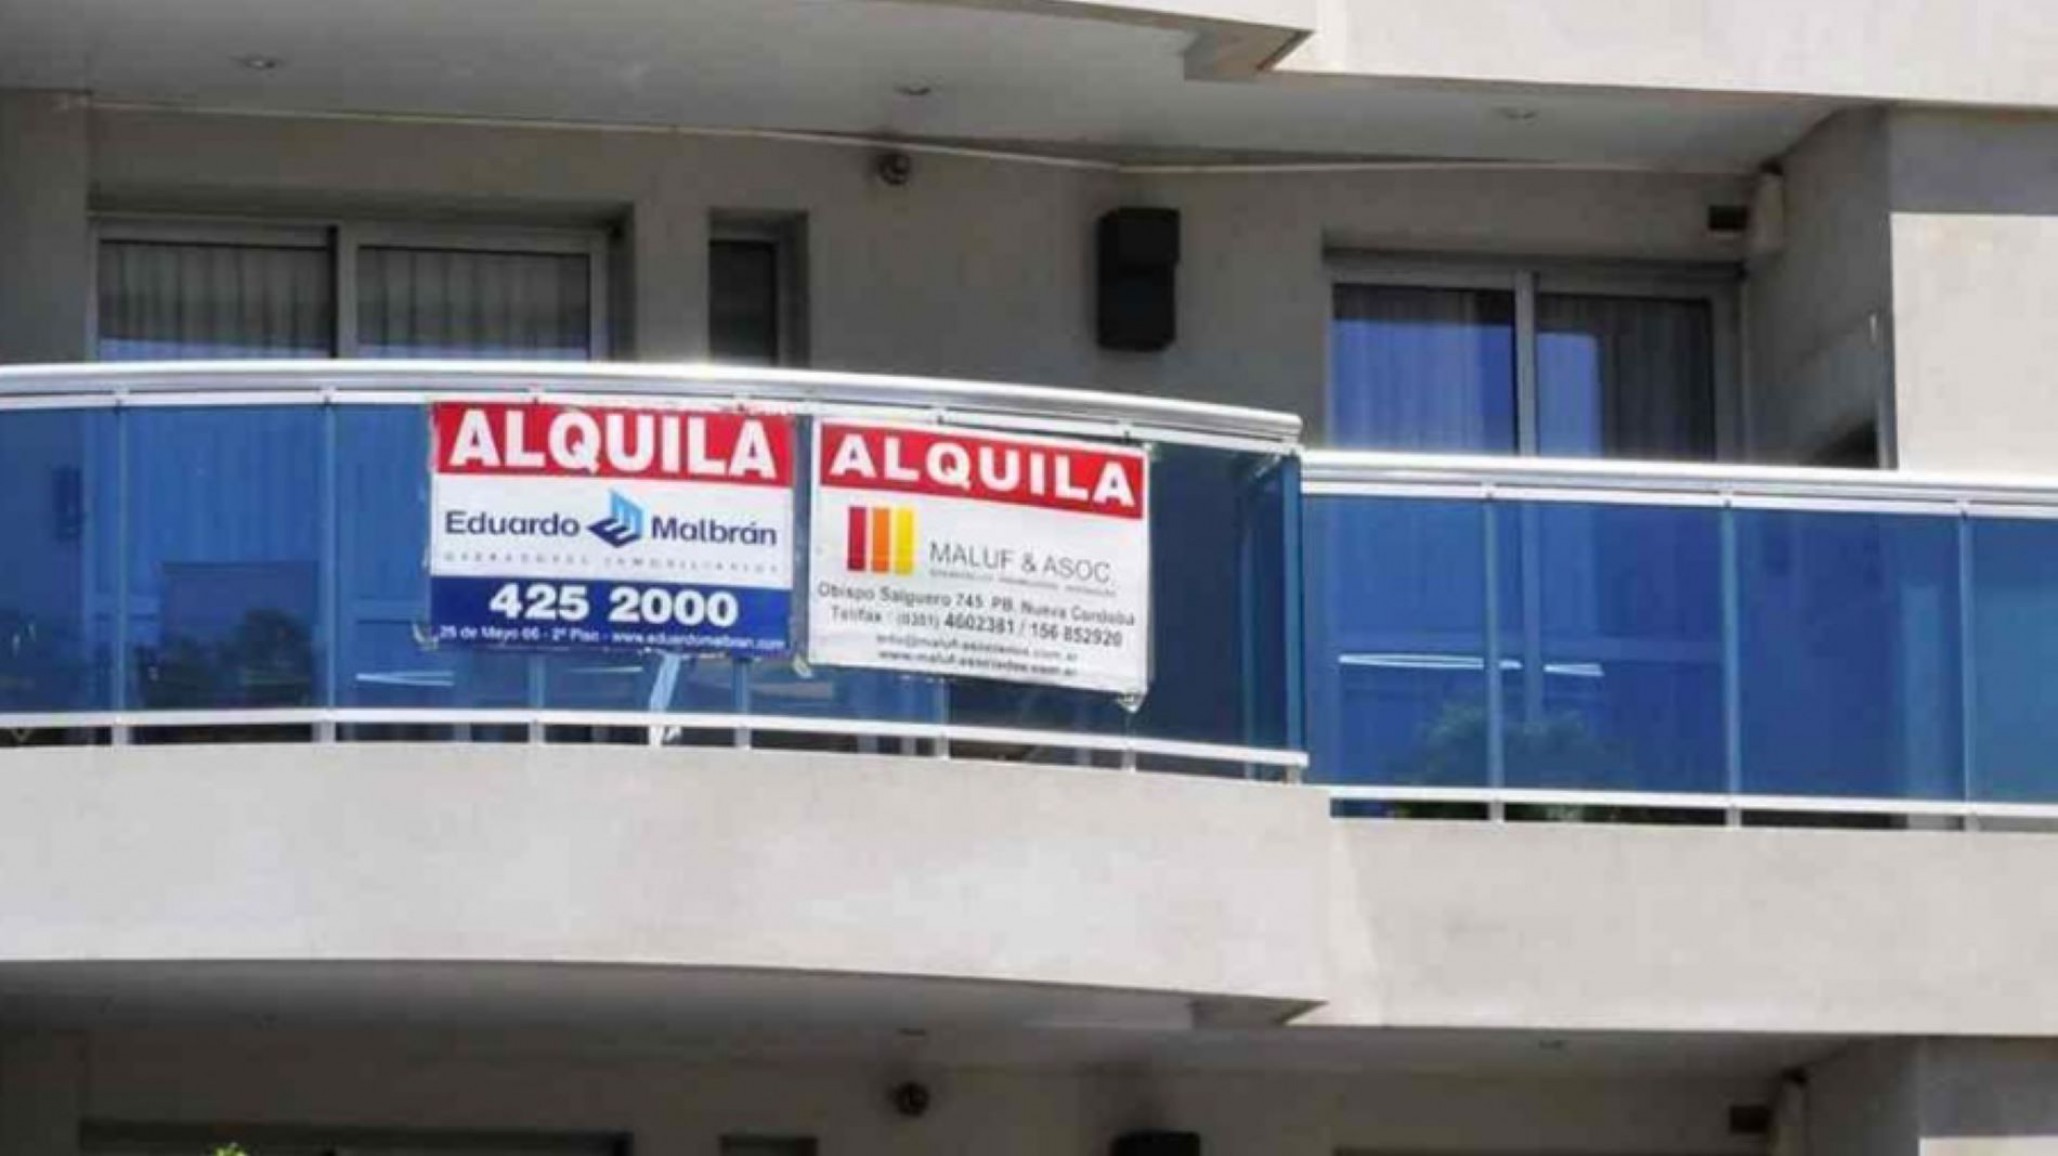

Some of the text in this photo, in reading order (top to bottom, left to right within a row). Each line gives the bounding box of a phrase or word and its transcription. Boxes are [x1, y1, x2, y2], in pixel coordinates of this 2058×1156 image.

[450, 408, 777, 479] ALQUILA
[829, 433, 1135, 507] ALQUILA
[445, 510, 777, 546] Eduardo Malbrán
[930, 540, 1013, 570] MALUF
[1021, 551, 1036, 573] &
[489, 582, 739, 627] 425 2000
[818, 581, 875, 601] Obispo
[880, 585, 951, 607] Salguero
[956, 592, 983, 609] 745
[1021, 600, 1066, 619] Nueva
[460, 626, 477, 639] de
[481, 626, 518, 642] Mayo
[571, 628, 599, 643] Piso
[1032, 622, 1058, 640] 156
[1064, 625, 1123, 647] 852920
